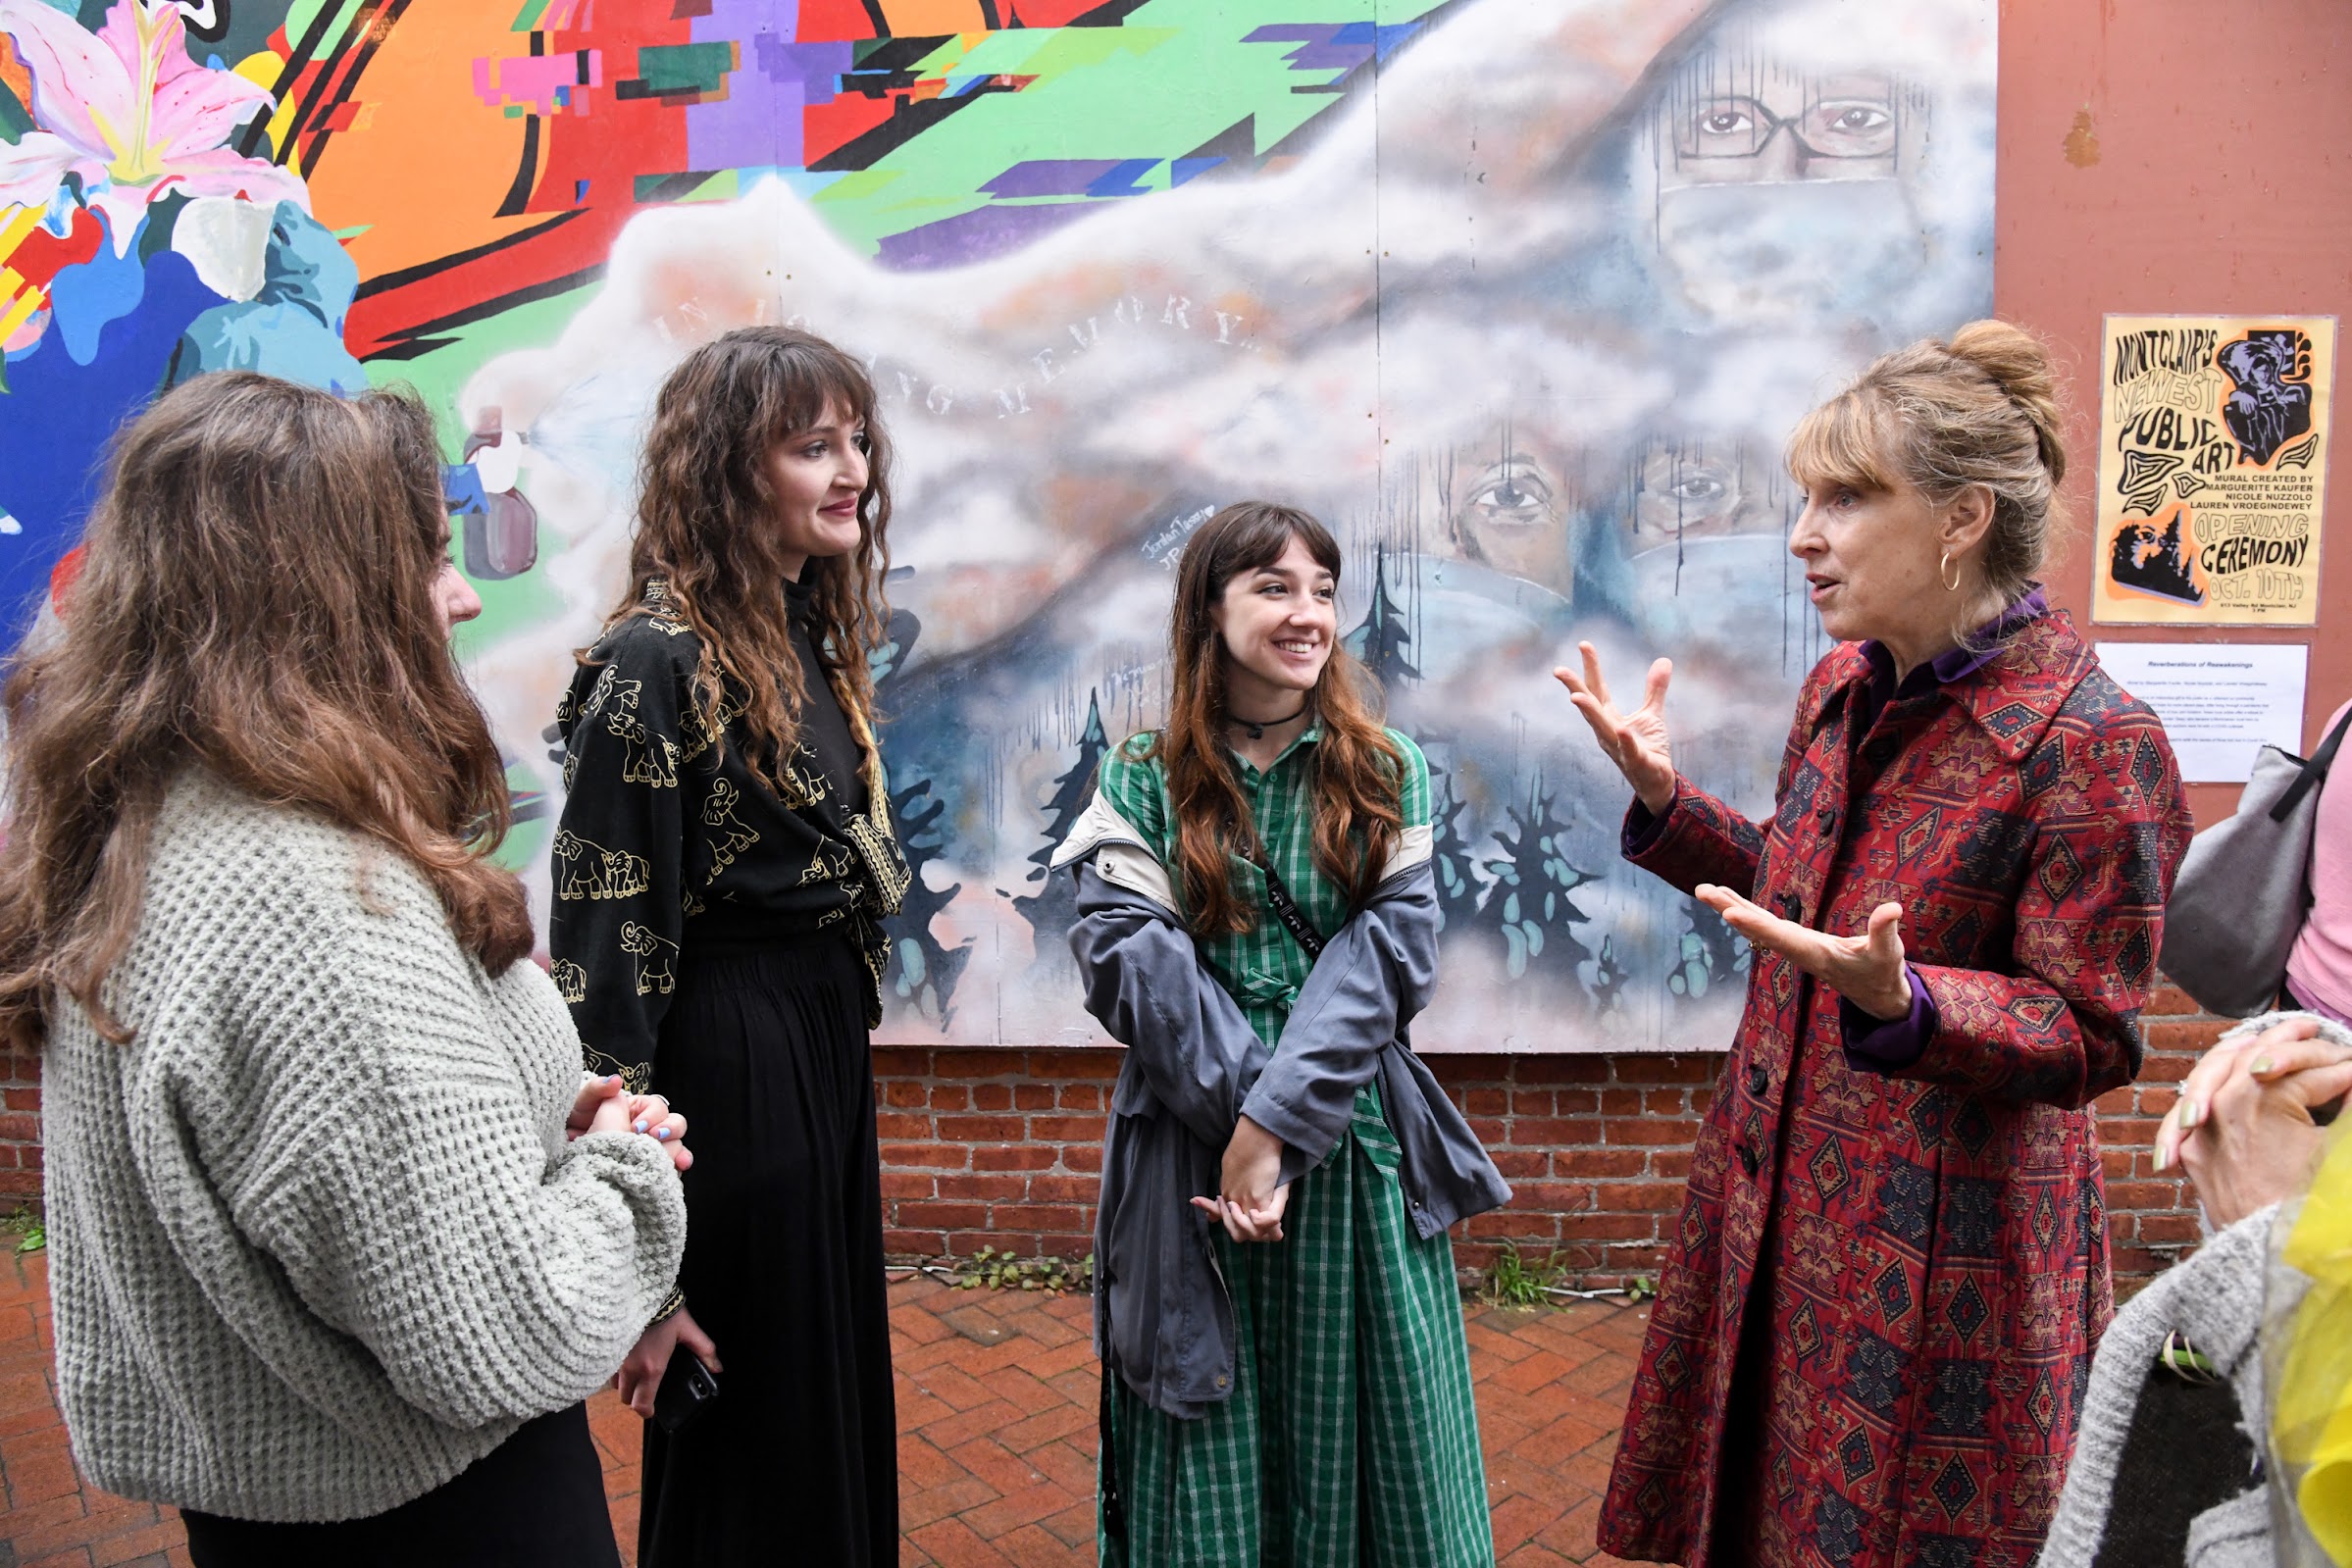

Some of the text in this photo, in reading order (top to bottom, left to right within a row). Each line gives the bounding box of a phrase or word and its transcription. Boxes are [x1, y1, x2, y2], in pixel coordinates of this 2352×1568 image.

[2114, 329, 2218, 385] MONTCLAIR'S
[2114, 368, 2223, 423] NEWEST
[2118, 406, 2219, 452] PUBLIC
[2192, 441, 2235, 475] ART
[2194, 512, 2309, 543] OPENING
[2201, 533, 2309, 575] CEREMONY
[2209, 568, 2304, 601] OCT. 10TH
